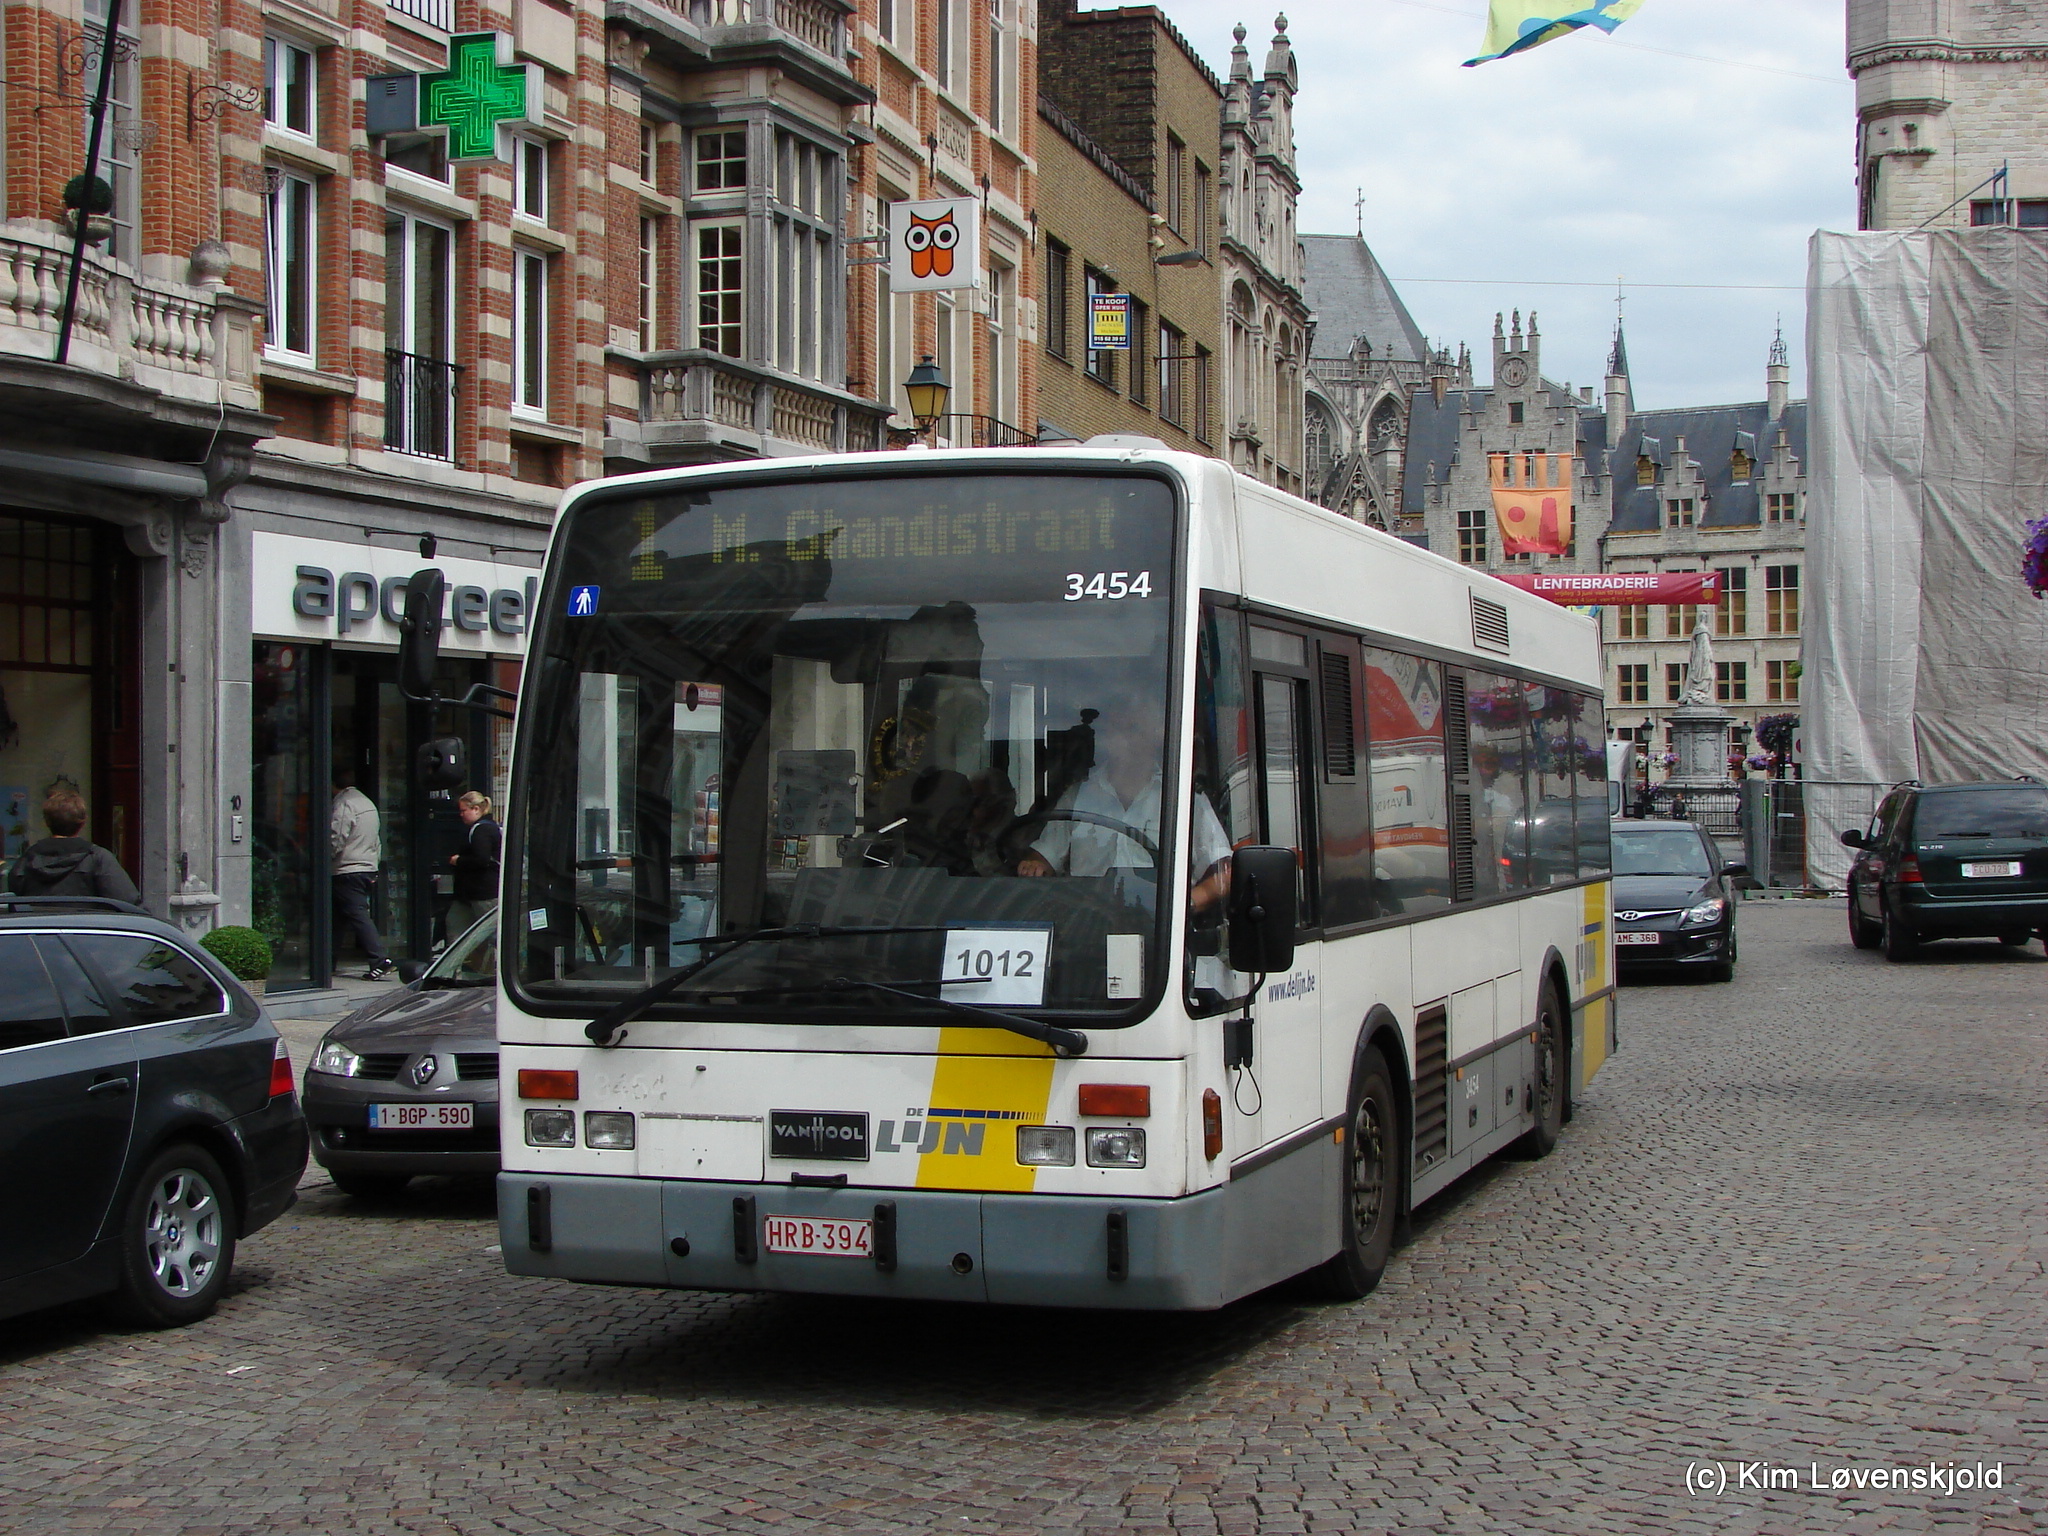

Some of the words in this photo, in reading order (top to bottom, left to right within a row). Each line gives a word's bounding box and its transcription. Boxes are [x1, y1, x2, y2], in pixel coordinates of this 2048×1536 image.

[631, 505, 664, 581] 1
[713, 511, 761, 564] M.
[786, 497, 1117, 562] Ghandistraat
[1063, 570, 1153, 601] 3454
[1533, 577, 1659, 590] LENTEBRADERIE
[230, 795, 242, 811] 10
[957, 949, 1034, 978] 1012
[1268, 969, 1316, 1003] www.delijn.be
[1465, 1074, 1479, 1099] 3454
[381, 1107, 470, 1125] 1-BGP-590
[906, 1107, 924, 1117] DE
[875, 1120, 986, 1156] LIJN
[769, 1221, 868, 1251] HRB-394
